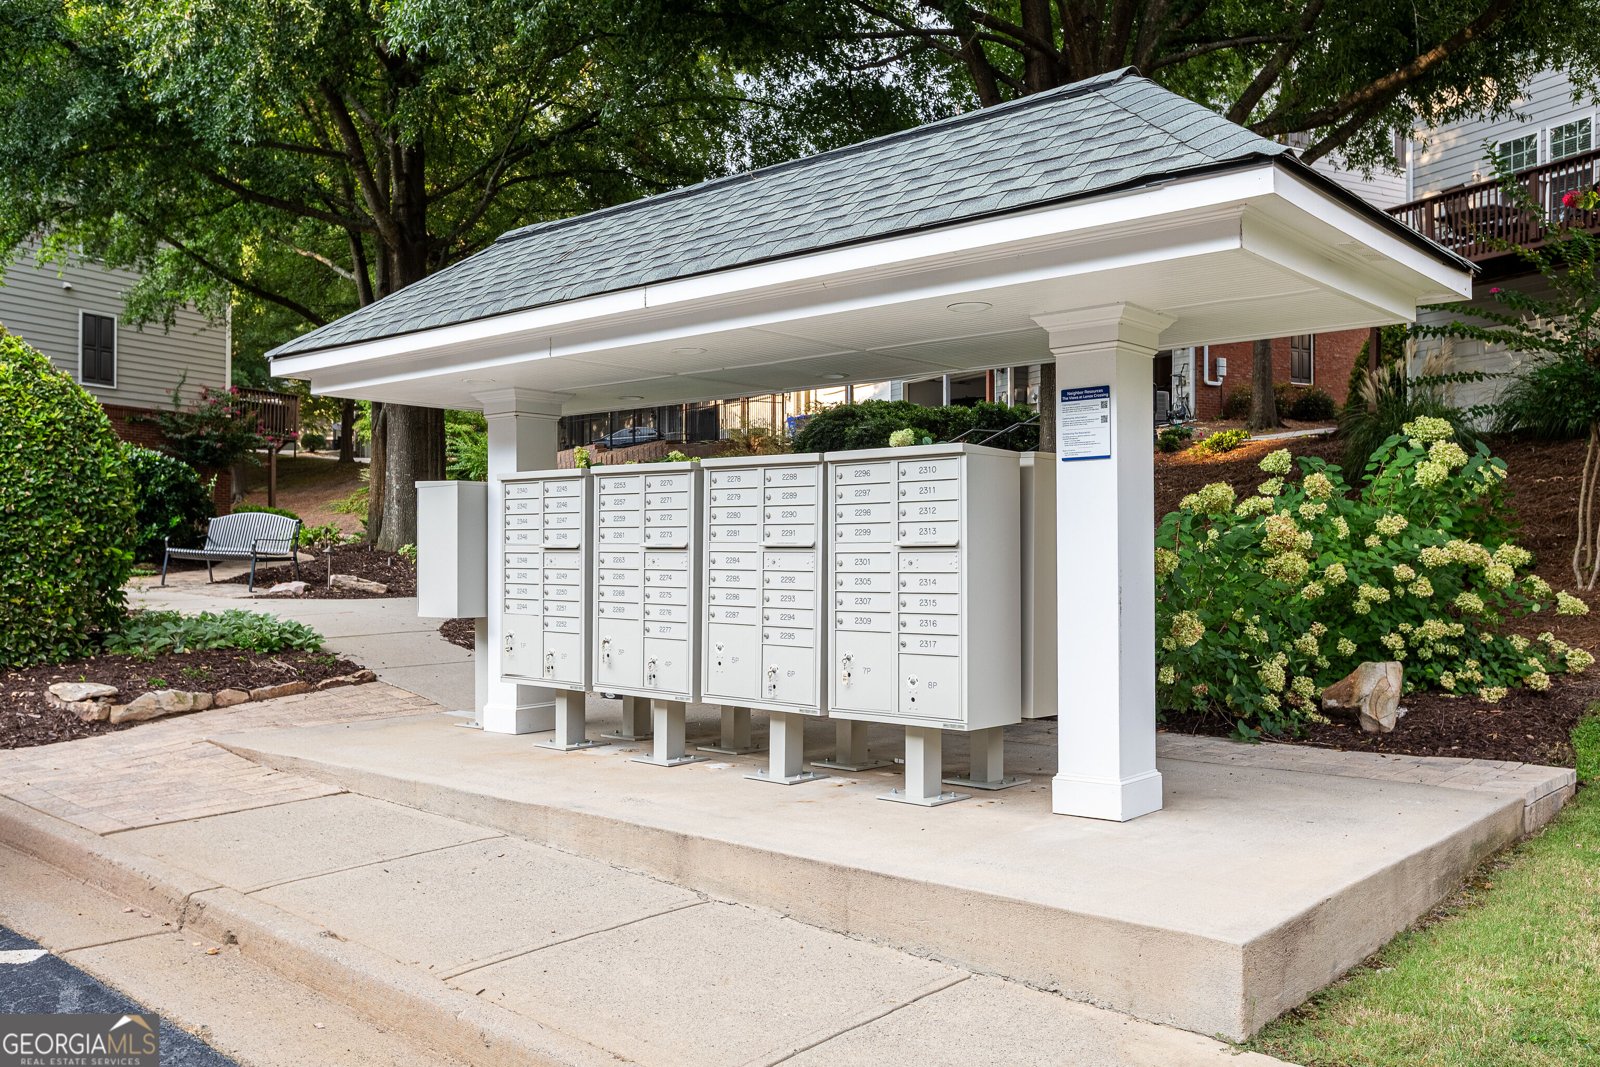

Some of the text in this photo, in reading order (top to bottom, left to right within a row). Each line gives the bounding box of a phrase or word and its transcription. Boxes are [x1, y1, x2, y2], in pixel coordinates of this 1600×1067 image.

[918, 466, 937, 474] 2310
[854, 489, 871, 497] 2297
[919, 486, 936, 495] 2311
[918, 506, 937, 515] 2312
[918, 527, 937, 535] 2313
[918, 578, 937, 586] 2314
[919, 599, 937, 607] 2315
[919, 620, 937, 628] 2316
[863, 667, 872, 675] 7P
